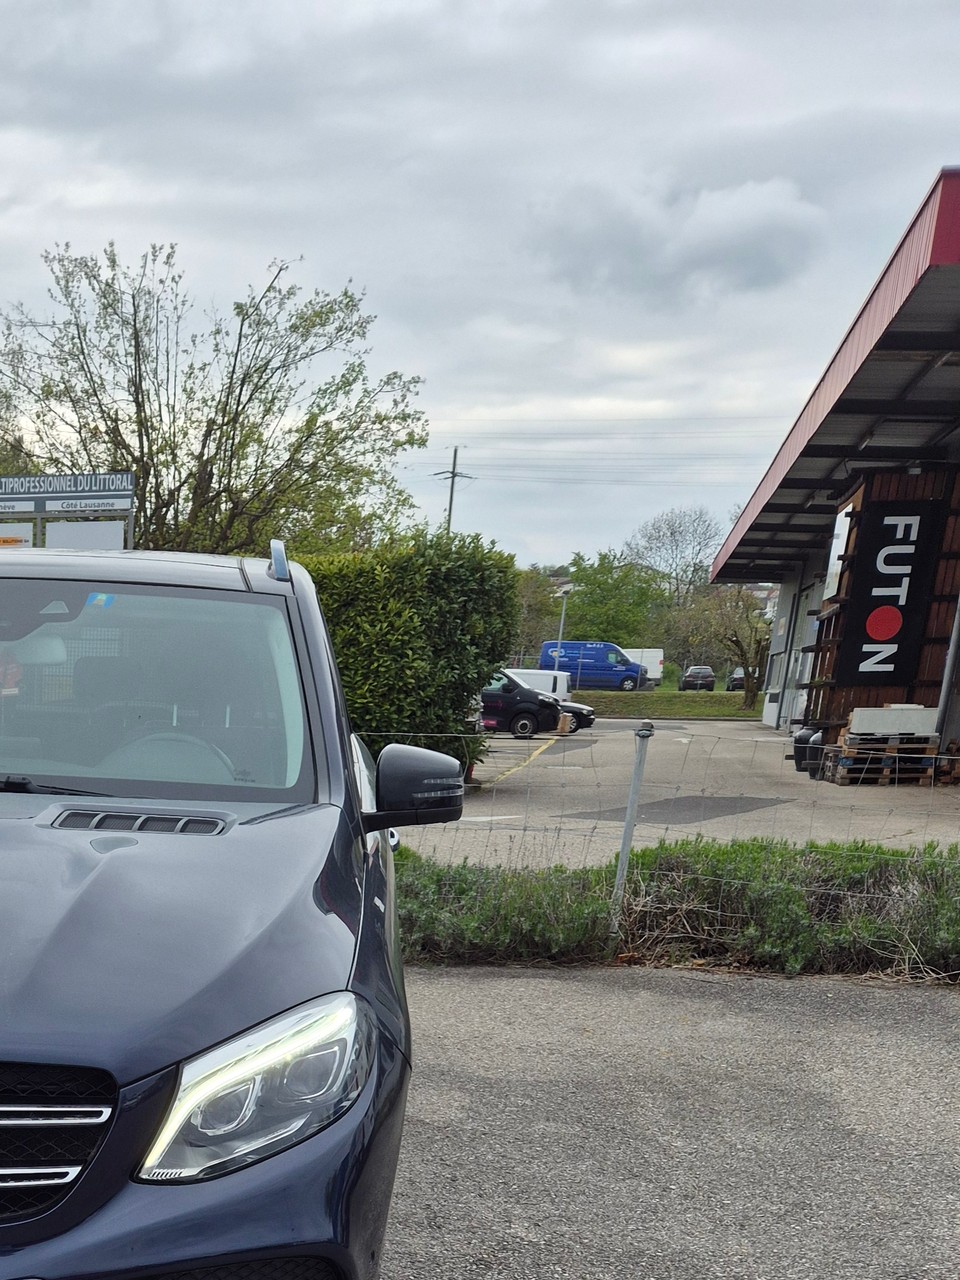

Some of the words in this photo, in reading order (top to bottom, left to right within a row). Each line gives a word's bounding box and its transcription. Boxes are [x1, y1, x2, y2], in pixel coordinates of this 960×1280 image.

[77, 474, 91, 491] DU
[91, 473, 133, 491] LITTORAL
[61, 501, 78, 509] Côté
[80, 501, 115, 509] Lausanne
